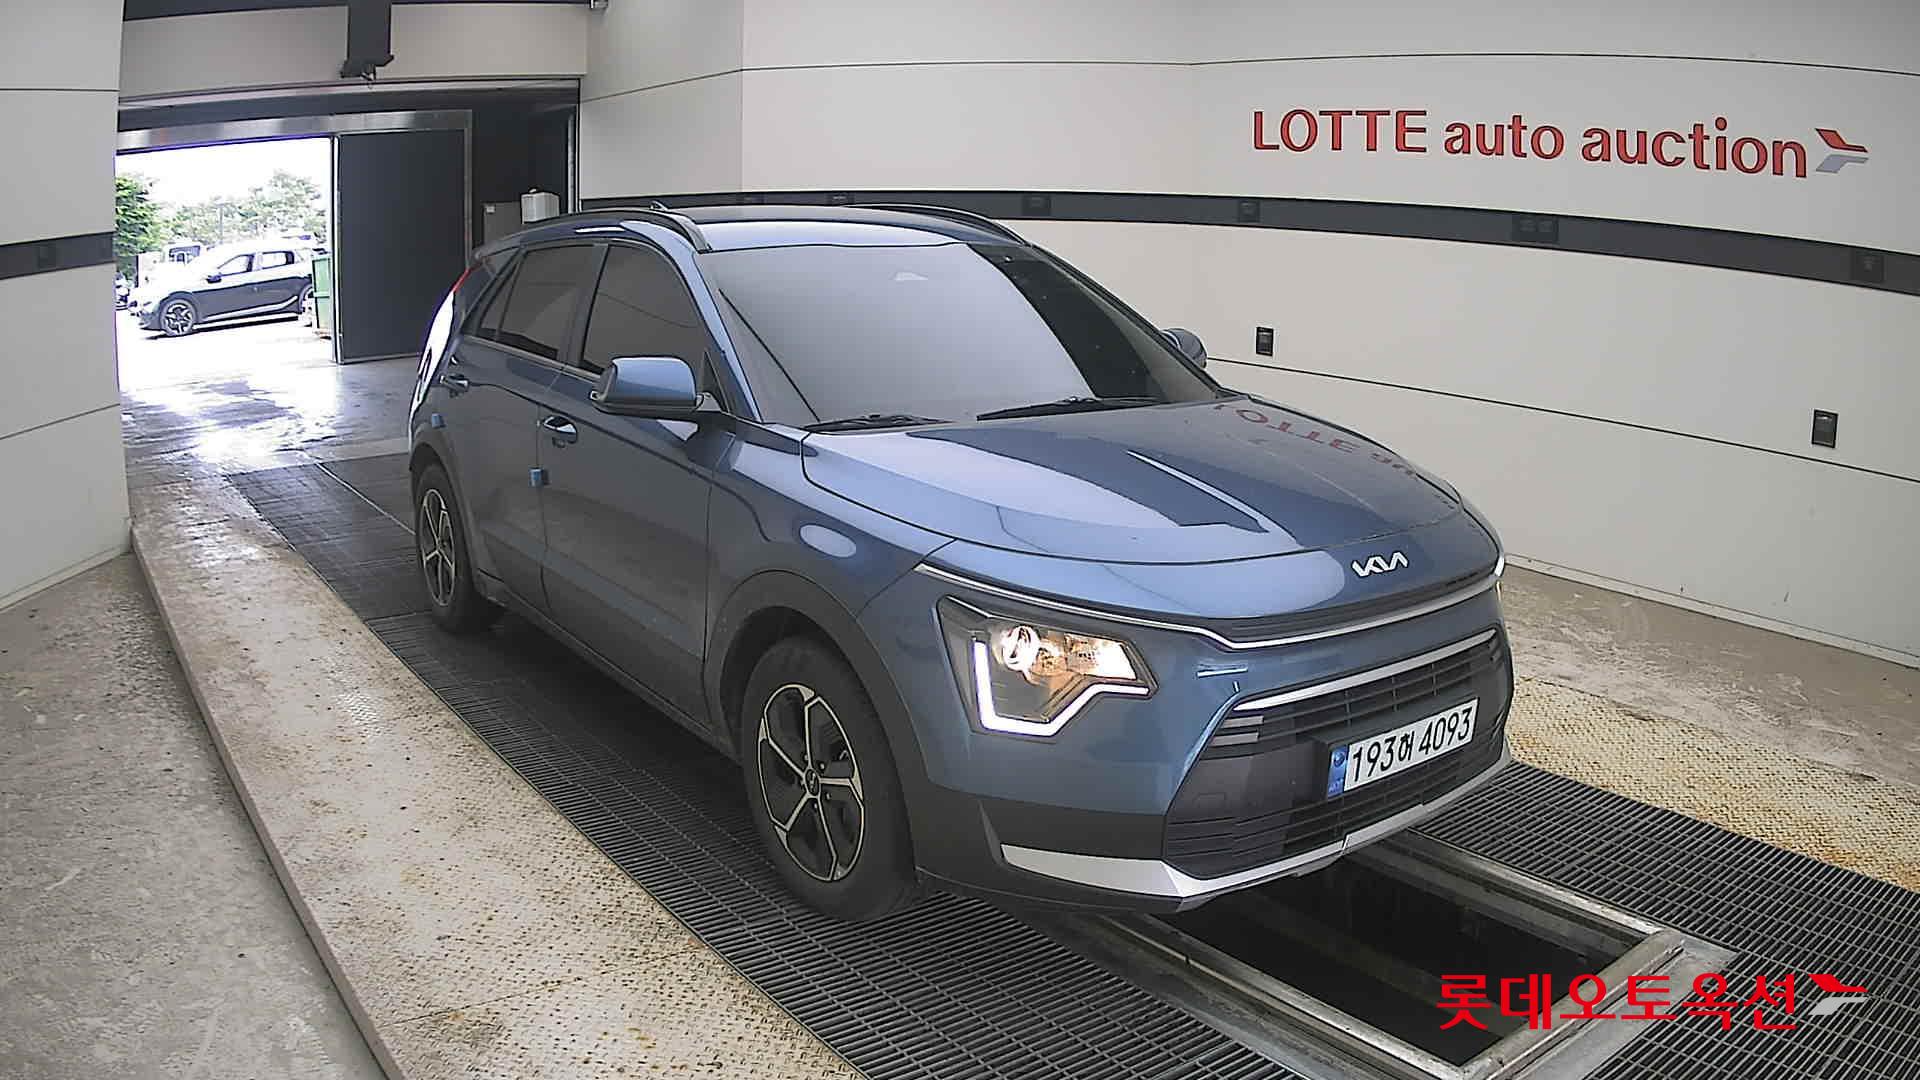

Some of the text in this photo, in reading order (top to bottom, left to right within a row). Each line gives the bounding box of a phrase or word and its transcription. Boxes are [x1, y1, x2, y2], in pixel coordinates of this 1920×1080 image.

[1253, 110, 1808, 178] LOTTE auto auction
[1418, 706, 1473, 756] 4093
